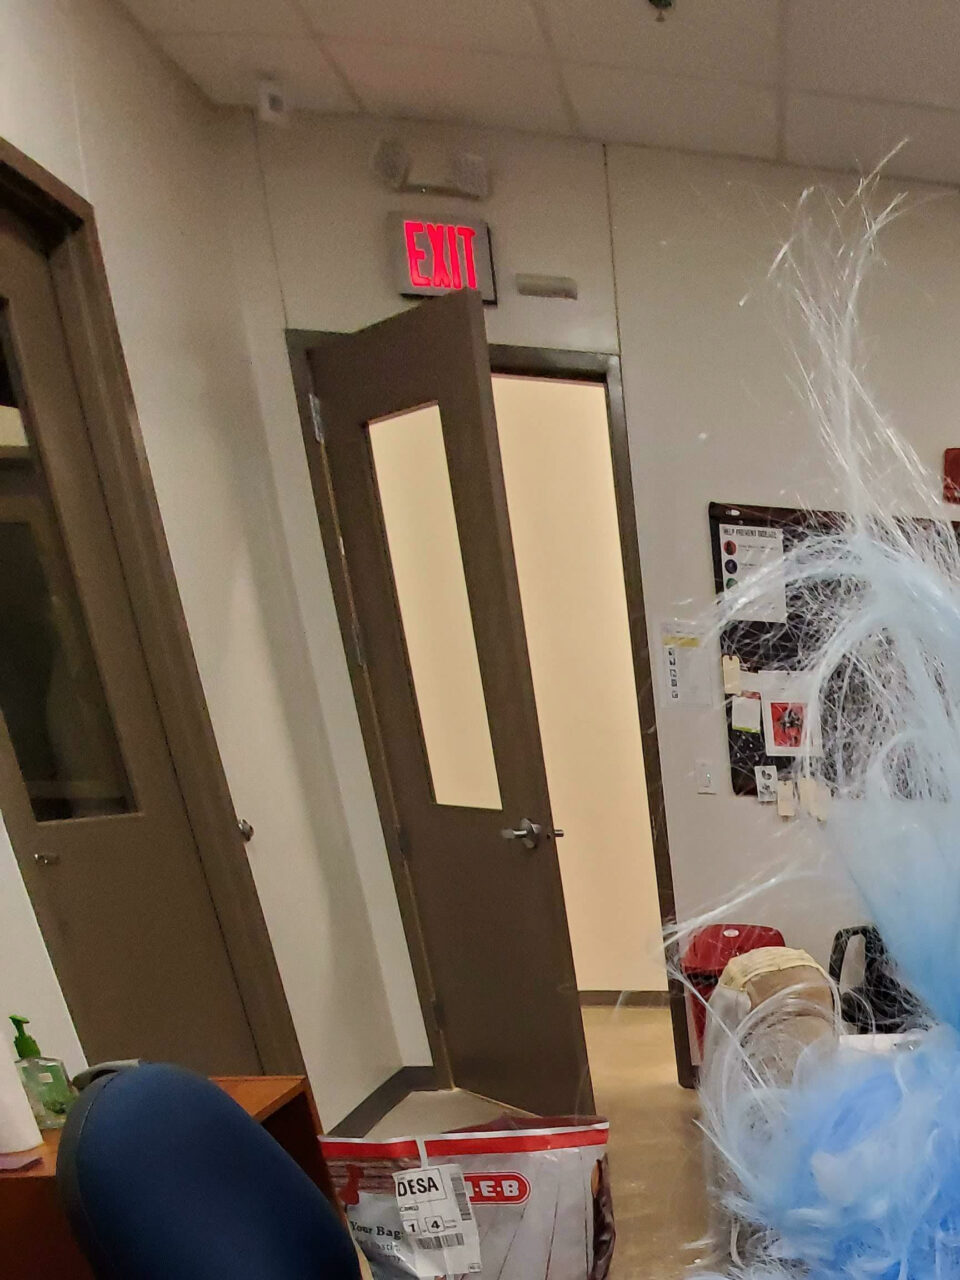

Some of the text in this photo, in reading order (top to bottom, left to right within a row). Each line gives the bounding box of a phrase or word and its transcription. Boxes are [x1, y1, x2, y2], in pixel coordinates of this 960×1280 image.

[403, 220, 478, 290] EXIT
[397, 1176, 440, 1197] DESA
[350, 1220, 373, 1235] Your
[408, 1223, 416, 1232] 1
[431, 1220, 441, 1229] 4
